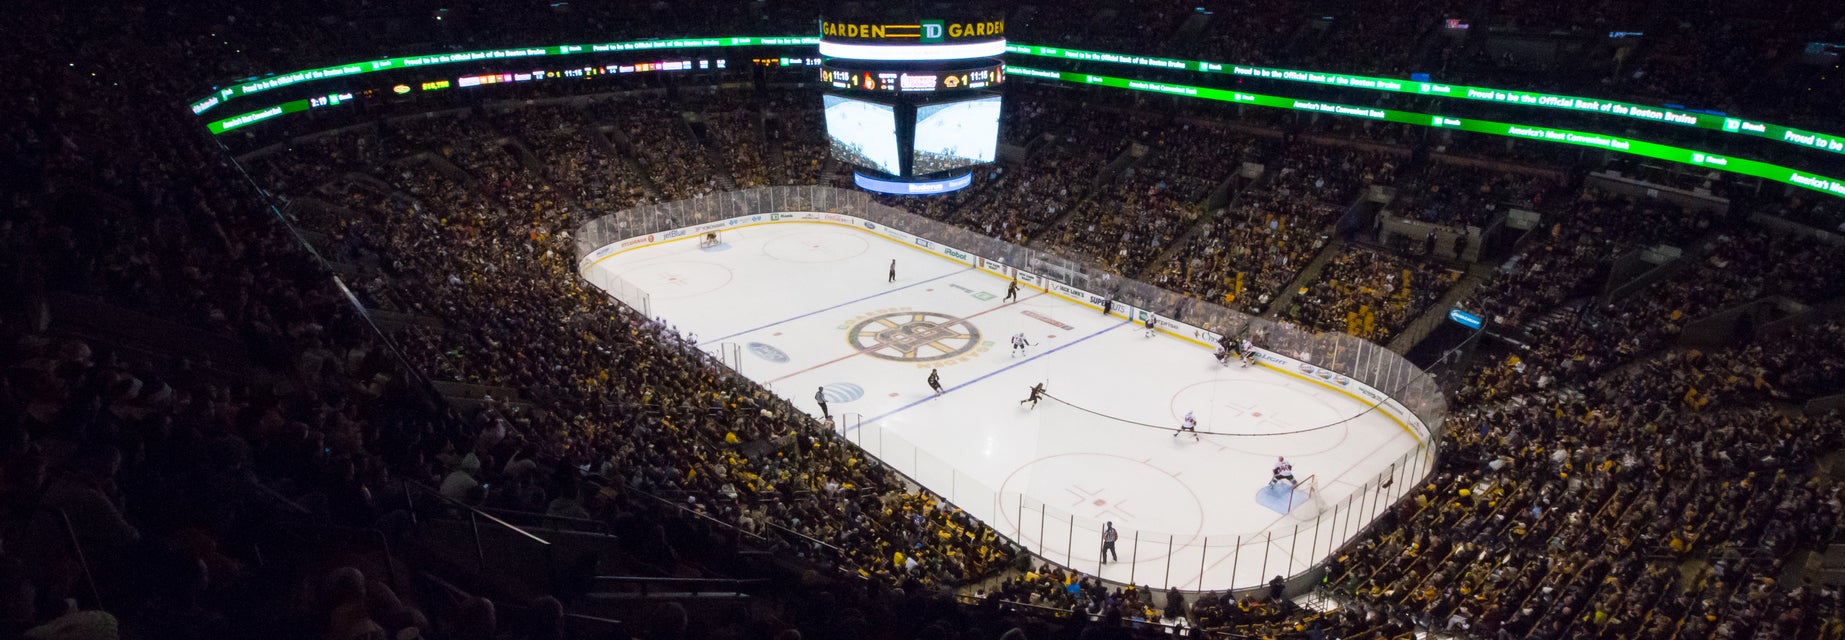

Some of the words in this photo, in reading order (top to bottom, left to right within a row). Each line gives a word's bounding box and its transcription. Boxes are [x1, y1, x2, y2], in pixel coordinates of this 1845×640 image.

[823, 22, 885, 38] GARDEN
[923, 24, 942, 38] TD
[949, 21, 1004, 38] GARDEN
[833, 71, 849, 81] 11:15
[852, 75, 858, 86] 1
[962, 74, 968, 85] 1
[971, 70, 988, 81] 11:15
[990, 71, 994, 82] 1
[1234, 67, 1252, 75] Proud
[1284, 72, 1307, 80] Official
[1309, 74, 1325, 82] Bank
[1350, 78, 1375, 87] Boston
[1376, 80, 1400, 89] Bruins
[1468, 89, 1494, 99] Proud
[1507, 93, 1519, 102] be
[1521, 95, 1536, 103] the
[1539, 96, 1573, 107] Official
[1575, 100, 1599, 110] Bank
[1601, 103, 1612, 111] of
[1613, 105, 1628, 114] the
[1630, 107, 1663, 119] Boston
[1664, 112, 1696, 124] Bruins
[1508, 126, 1544, 137] America's
[1545, 131, 1565, 140] Most
[1566, 134, 1610, 146] Convenient
[1611, 139, 1629, 150] Bank
[1784, 130, 1815, 145] Proud
[1816, 138, 1827, 147] to
[1828, 139, 1843, 151] be
[1790, 173, 1828, 189] America's
[945, 248, 966, 260] iRobot
